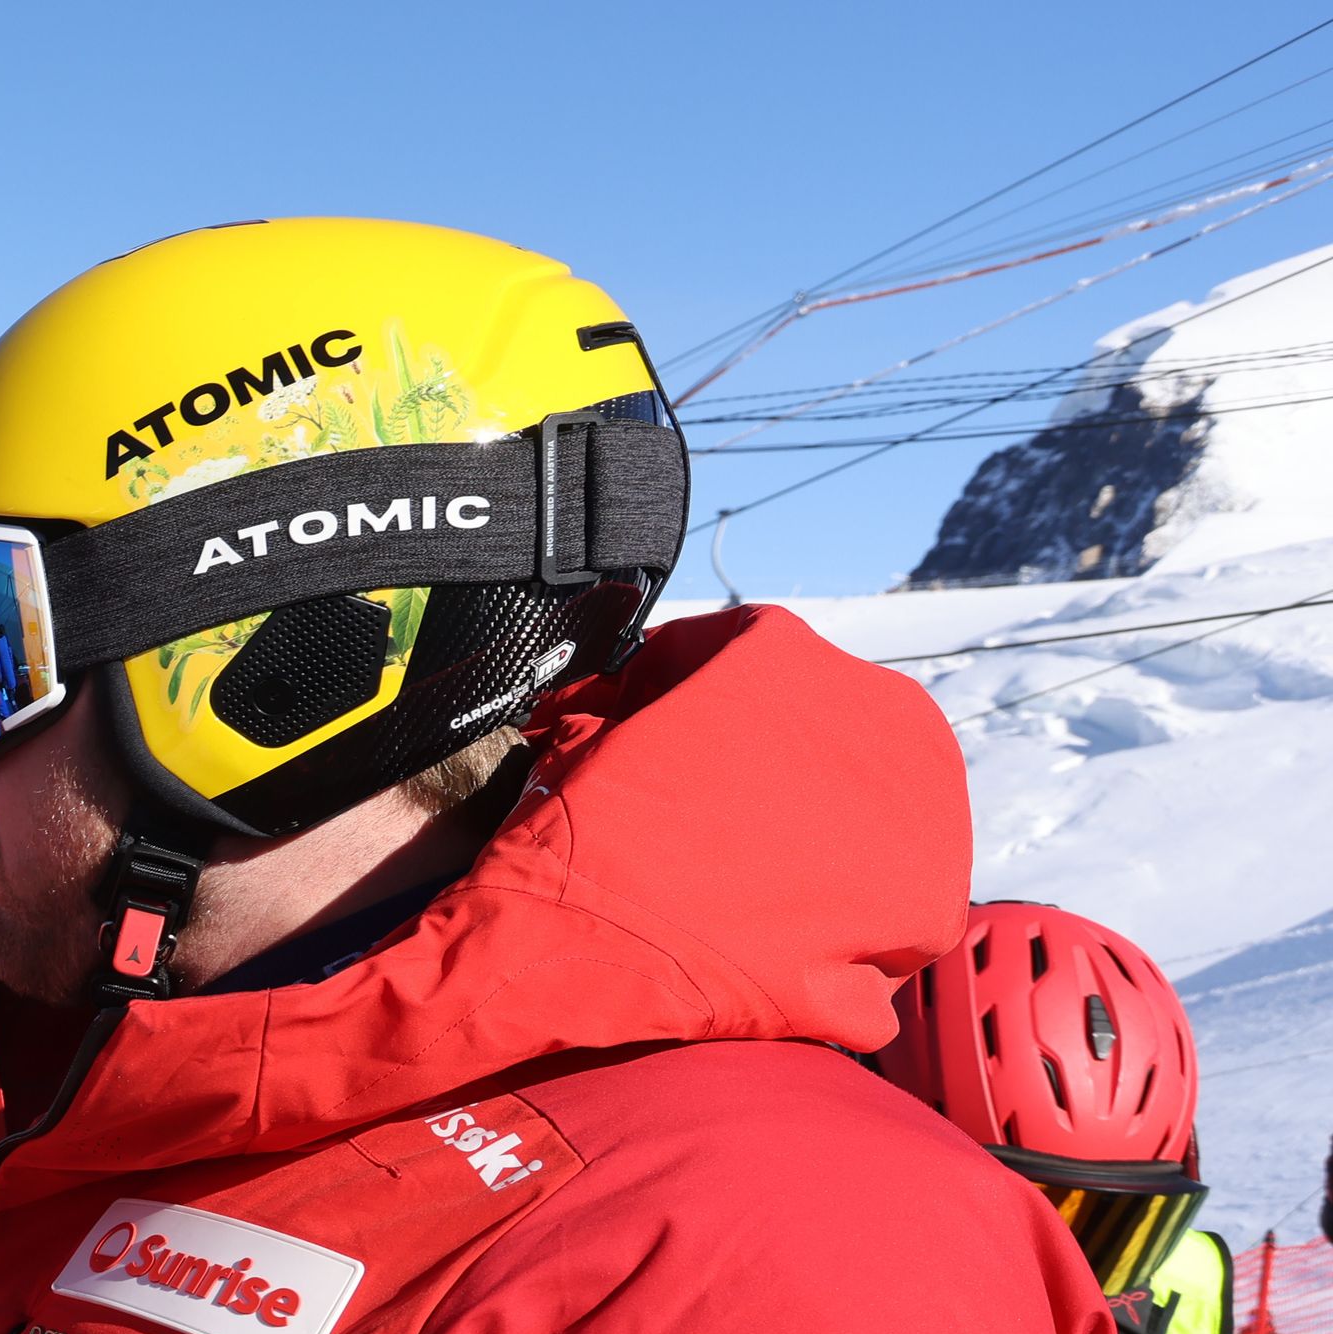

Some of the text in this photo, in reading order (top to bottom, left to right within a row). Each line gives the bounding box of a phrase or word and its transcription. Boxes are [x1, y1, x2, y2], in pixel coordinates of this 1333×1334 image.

[105, 329, 363, 481] ATOMIC
[193, 495, 491, 576] ATOMIC
[545, 440, 555, 558] ENGINEERED IN AUSTRIA
[450, 691, 513, 729] CARBON
[125, 1234, 301, 1327] Sunrise
